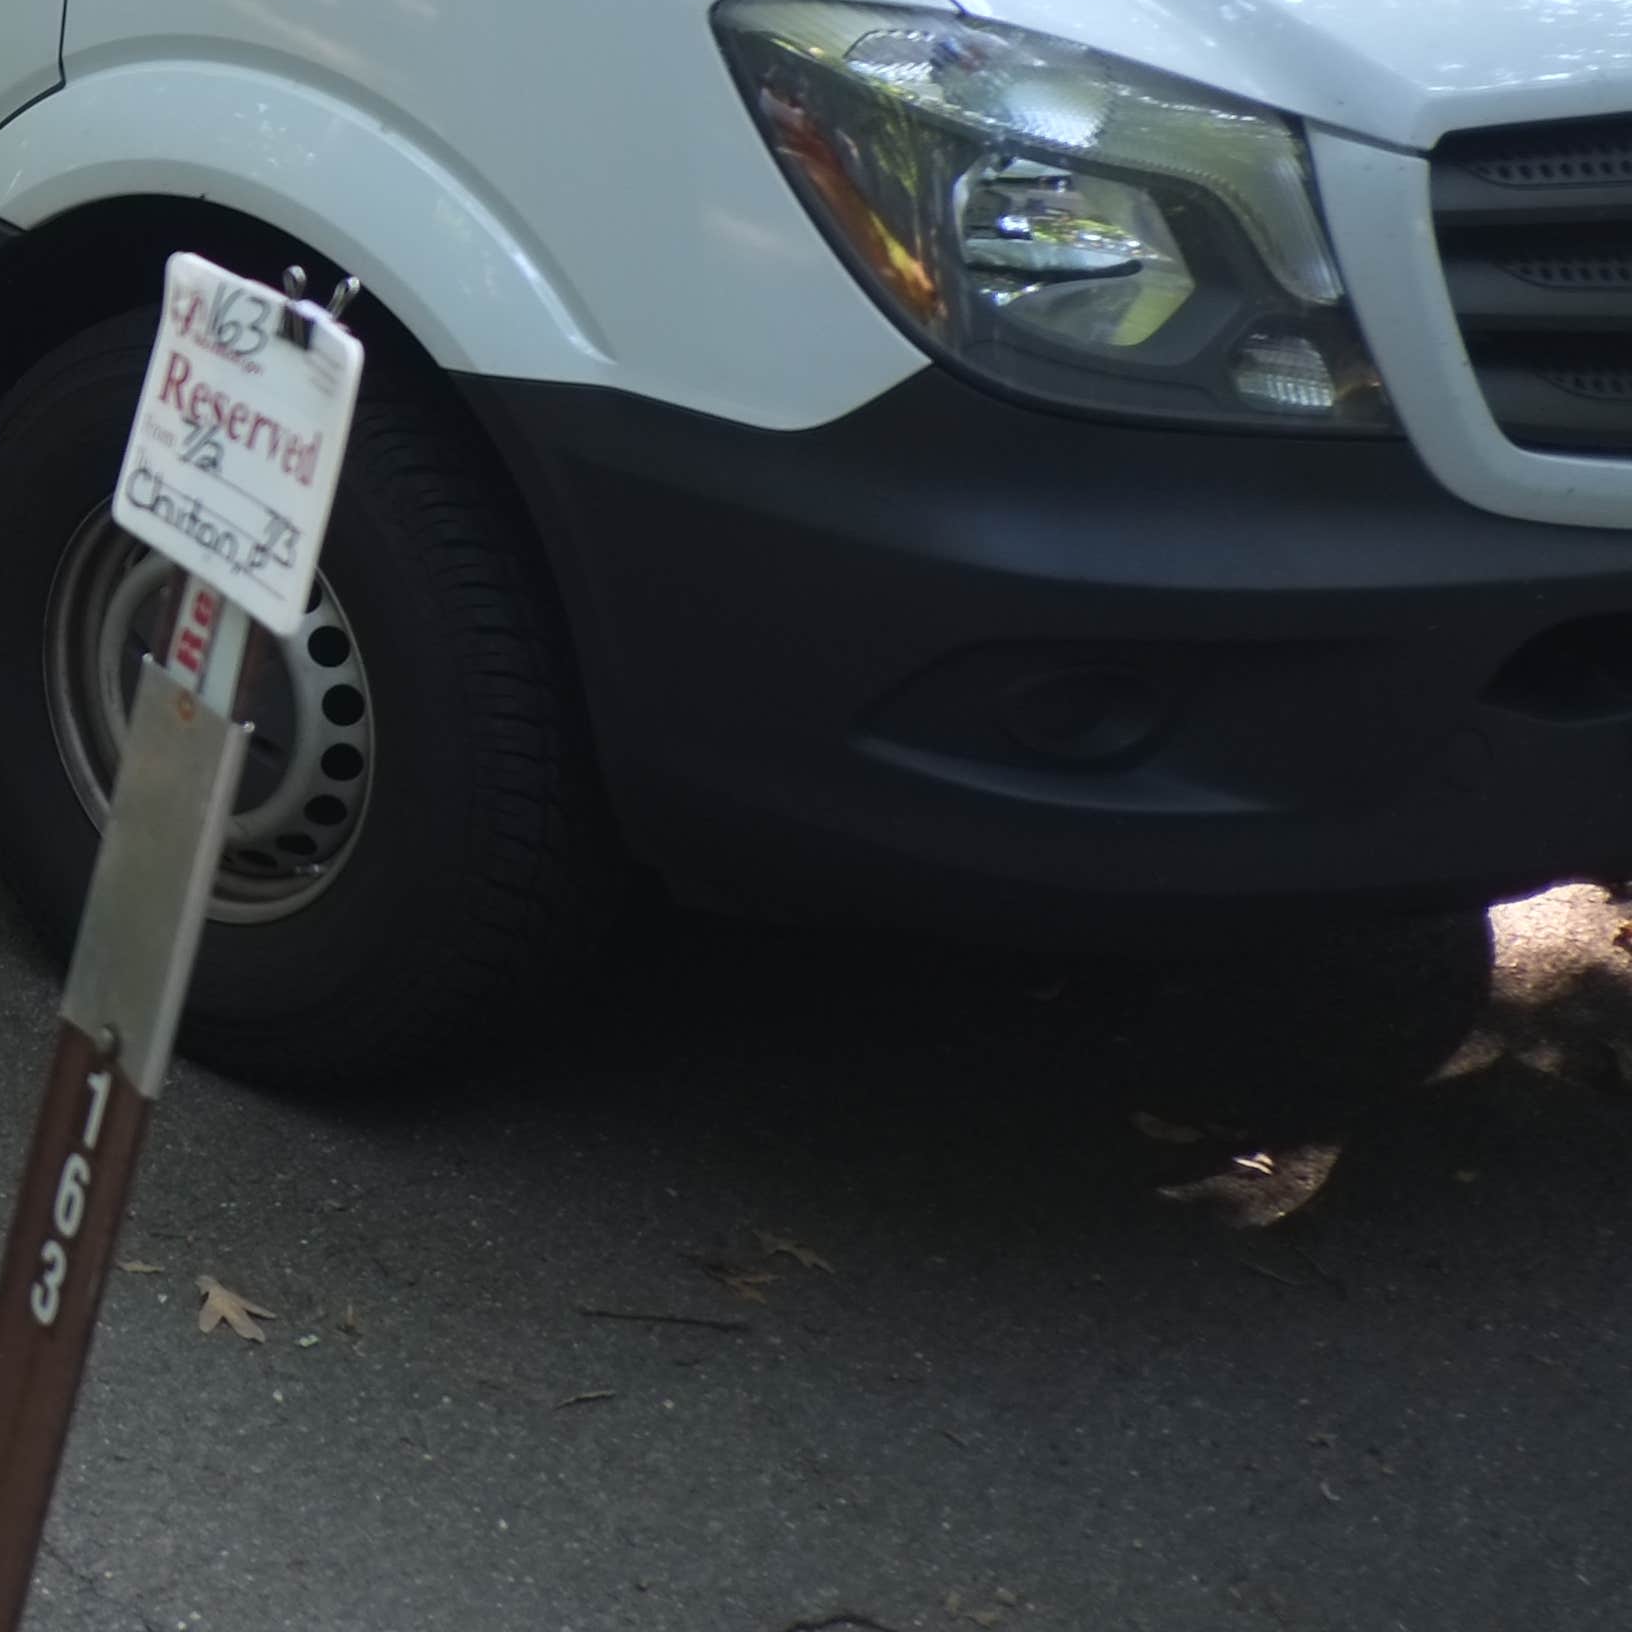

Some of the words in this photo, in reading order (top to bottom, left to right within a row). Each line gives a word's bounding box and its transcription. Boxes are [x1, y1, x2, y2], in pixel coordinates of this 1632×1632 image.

[209, 280, 271, 357] 163
[158, 350, 324, 487] Reserved
[30, 1070, 112, 1327] 163
